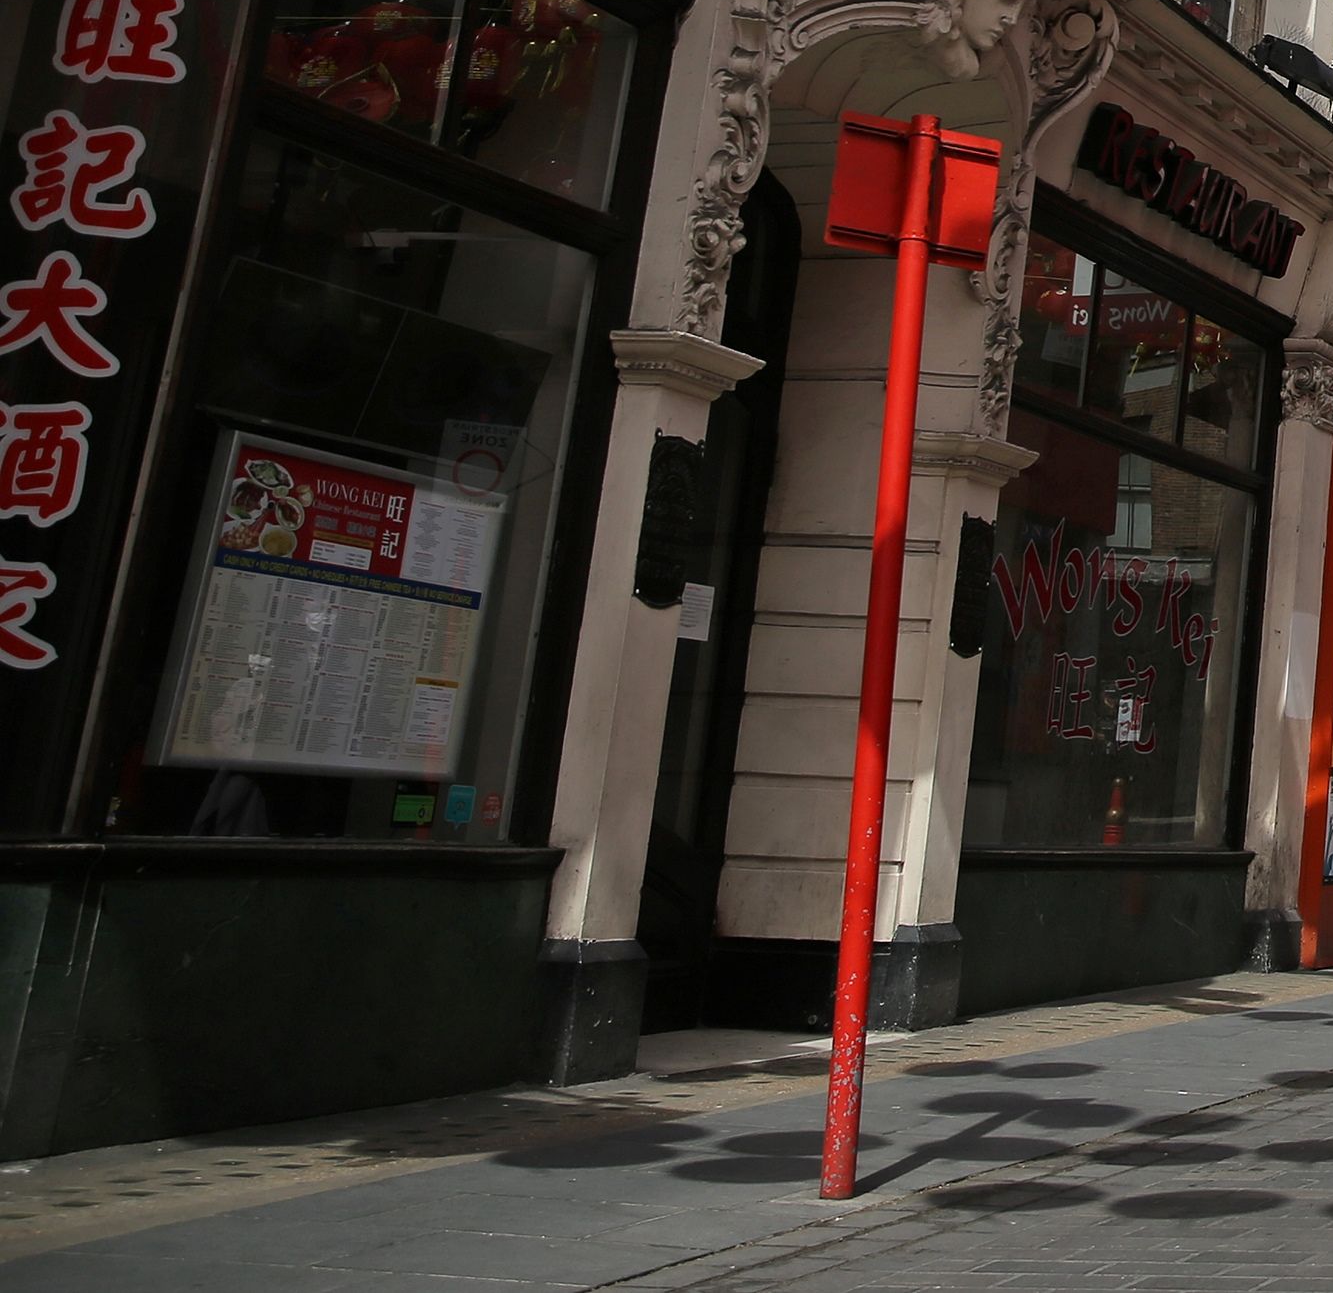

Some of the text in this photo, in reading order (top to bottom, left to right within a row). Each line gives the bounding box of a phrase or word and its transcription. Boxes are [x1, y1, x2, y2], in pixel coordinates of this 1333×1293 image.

[1080, 103, 1306, 278] RESTAURANT
[316, 479, 385, 509] WONG KEI
[380, 494, 407, 560] 旺記
[991, 516, 1219, 681] Wong Kei
[1047, 651, 1157, 755] 旺記
